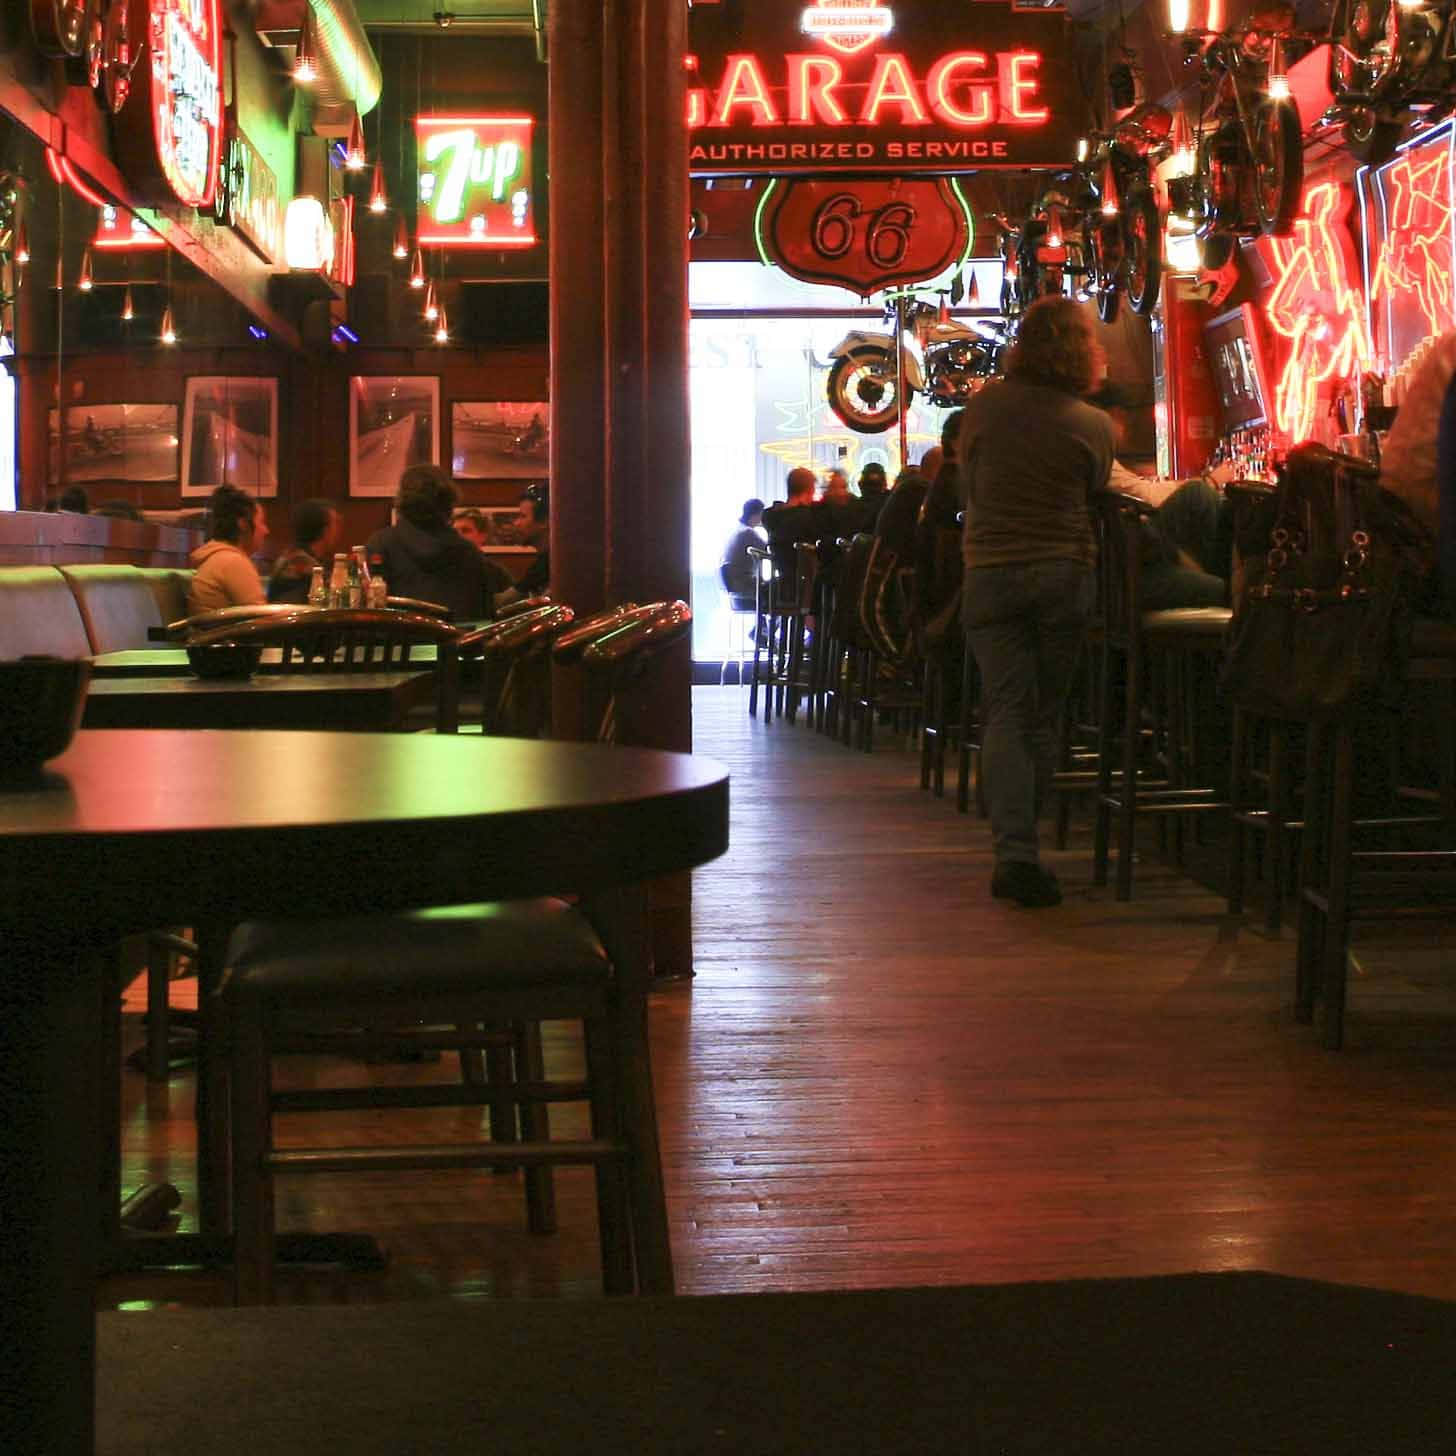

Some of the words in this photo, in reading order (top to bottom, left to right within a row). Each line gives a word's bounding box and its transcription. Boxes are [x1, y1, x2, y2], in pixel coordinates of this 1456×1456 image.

[689, 142, 875, 161] AUTHORIZED
[887, 141, 1008, 158] SERVICE
[810, 192, 917, 270] 66
